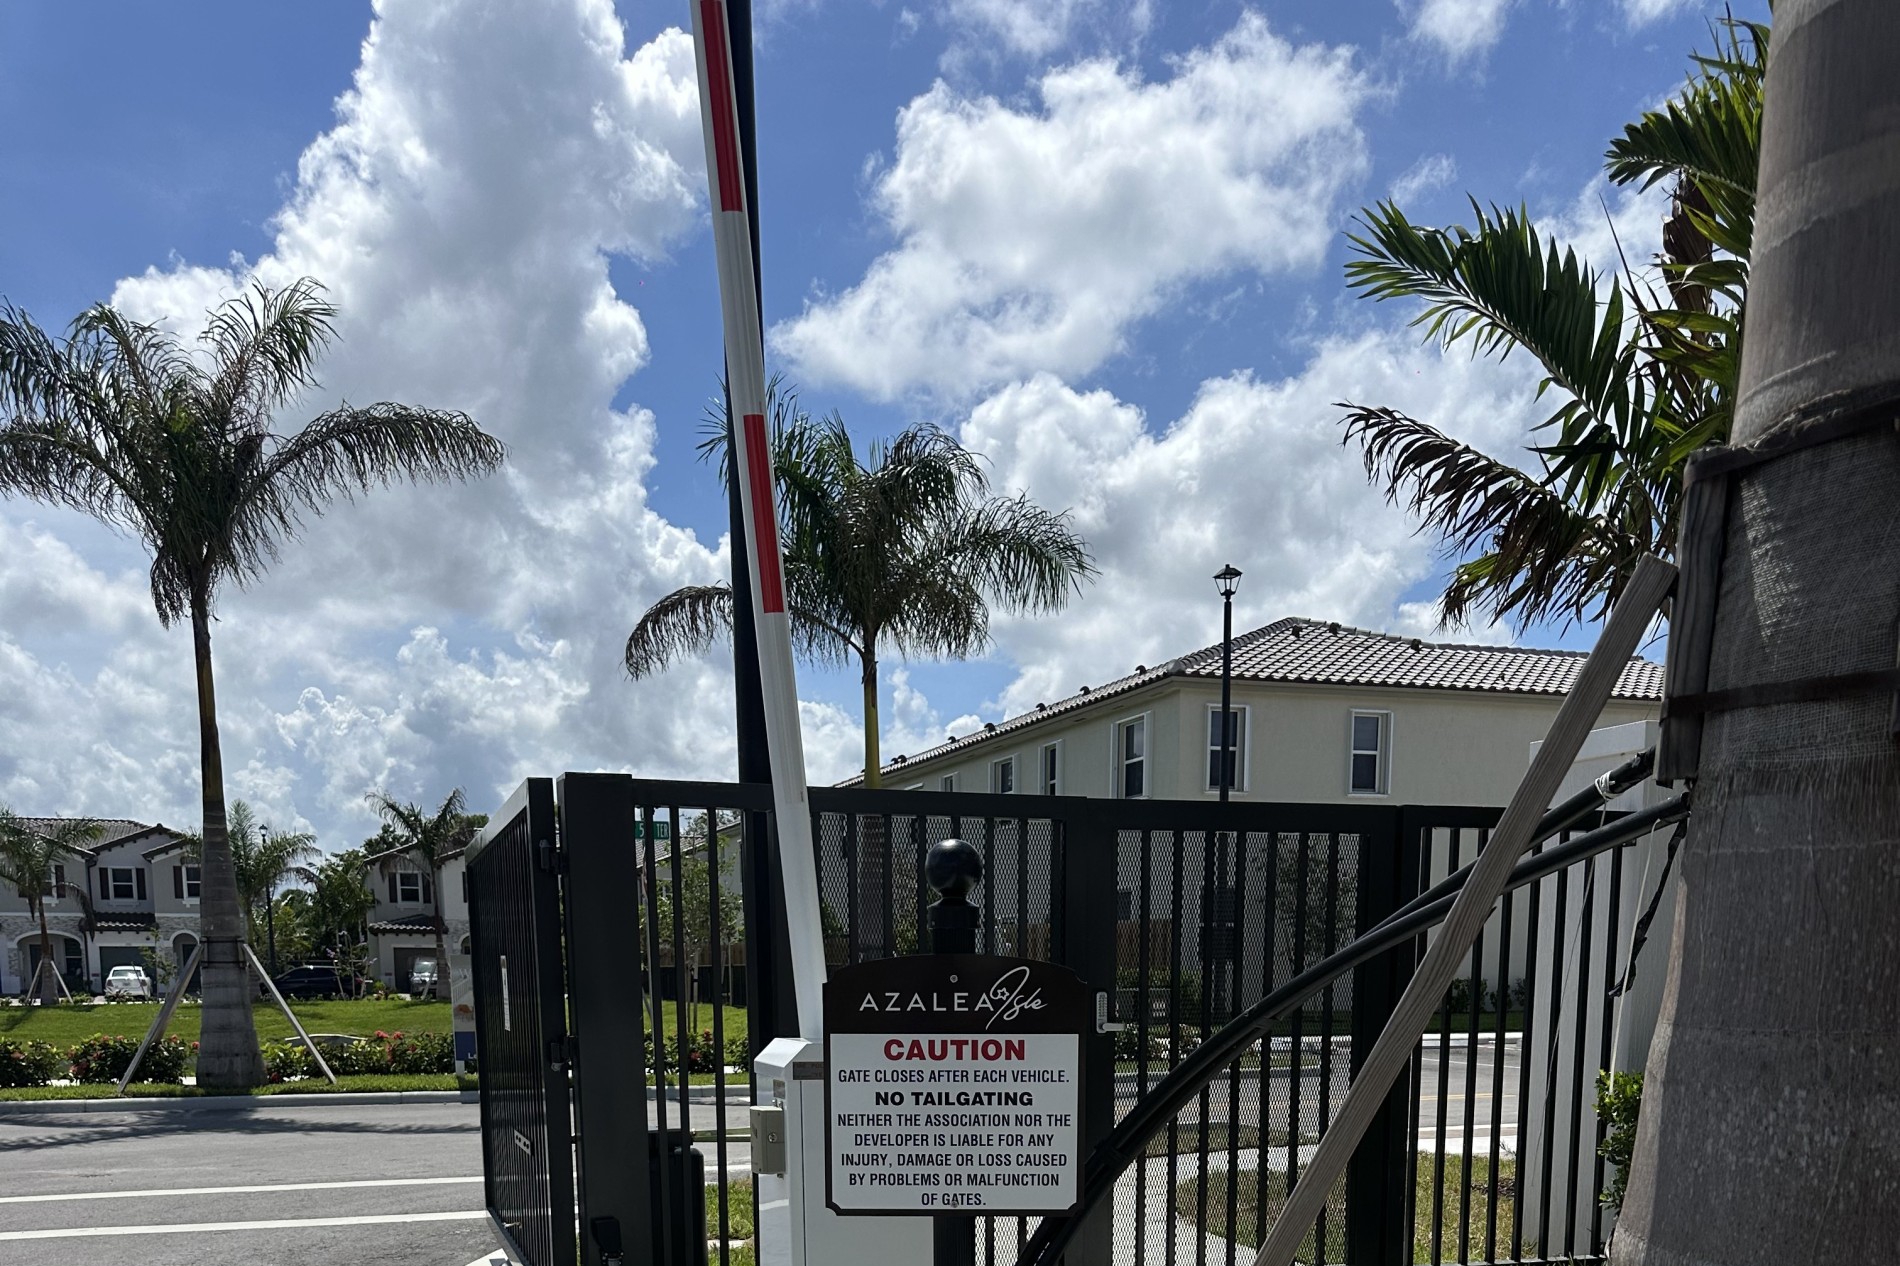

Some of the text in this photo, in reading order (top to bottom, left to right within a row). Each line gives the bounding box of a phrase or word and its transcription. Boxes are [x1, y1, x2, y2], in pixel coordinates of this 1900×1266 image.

[859, 991, 995, 1012] AZALEA
[883, 1039, 1025, 1061] CAUTION
[838, 1070, 1070, 1082] GATE CLOSES AFTER EACH VEHICLE.
[875, 1092, 1033, 1106] NO TAILGATING
[837, 1114, 1071, 1126] NEITHER THE ASSOCIATION NOR THE
[854, 1134, 1055, 1146] DEVELOPER IS LIABLE FOR ANY
[841, 1154, 1068, 1168] INJURY, DAMAGE OR LOSS CAUSED
[849, 1173, 1060, 1186] BY PROBLEMS OR MALFUNCTION
[921, 1193, 987, 1206] OF GATES.
